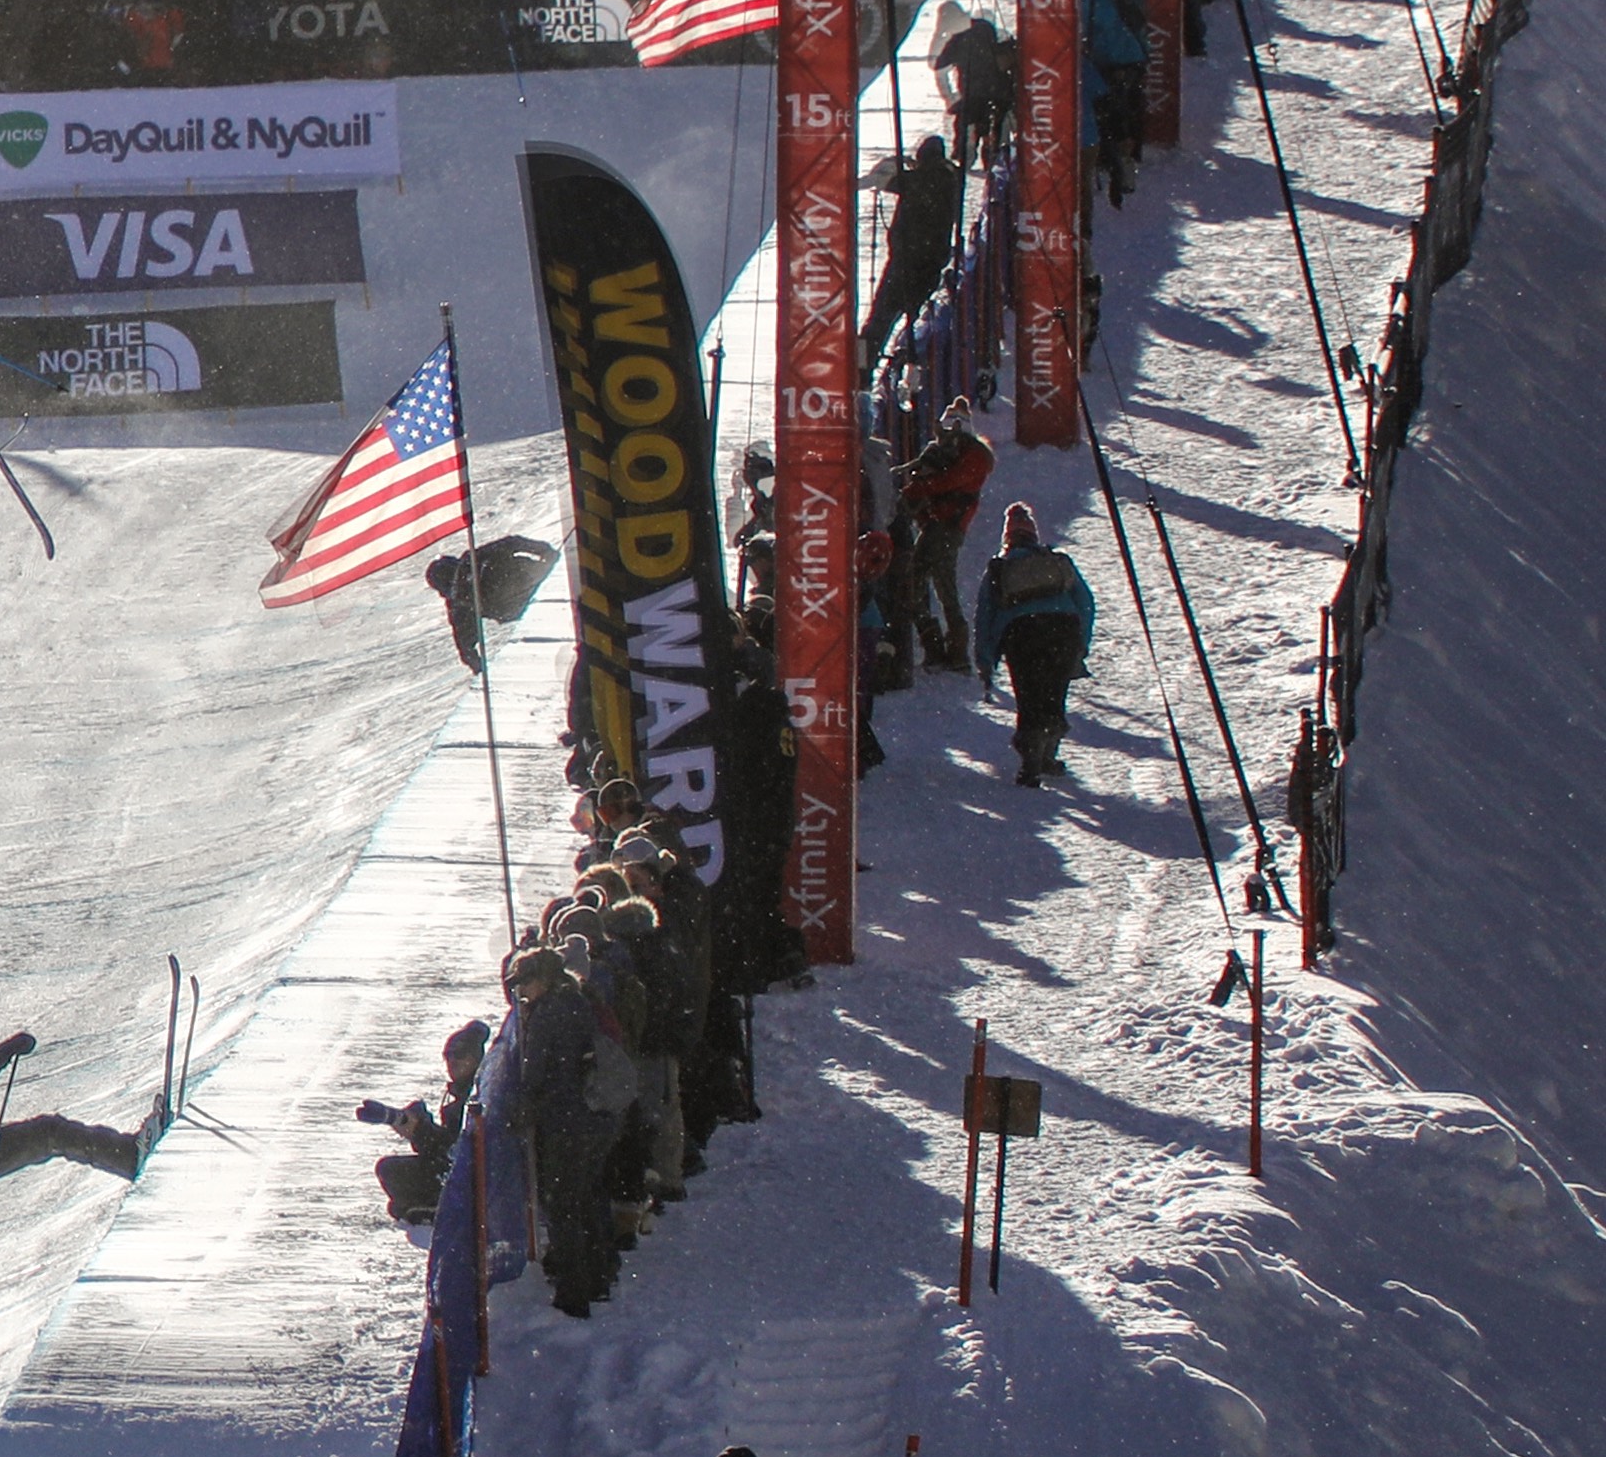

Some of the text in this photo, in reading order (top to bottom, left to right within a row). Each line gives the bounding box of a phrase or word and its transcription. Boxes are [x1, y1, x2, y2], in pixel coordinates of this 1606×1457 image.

[518, 6, 596, 26] NORTH
[542, 23, 596, 43] FACE
[785, 92, 833, 129] 15
[1023, 58, 1060, 168] xfinity
[63, 112, 372, 163] DayQuil & NyQuil
[43, 208, 255, 280] VISA
[1016, 211, 1043, 252] 5
[795, 189, 842, 329] xfinity
[85, 320, 144, 347] THE
[1023, 301, 1060, 411] xfinity
[38, 345, 145, 374] NORTH
[70, 369, 145, 398] FACE
[783, 386, 830, 421] 10
[791, 481, 838, 620] xfinity
[784, 677, 818, 728] 5
[788, 791, 837, 932] xfinity
